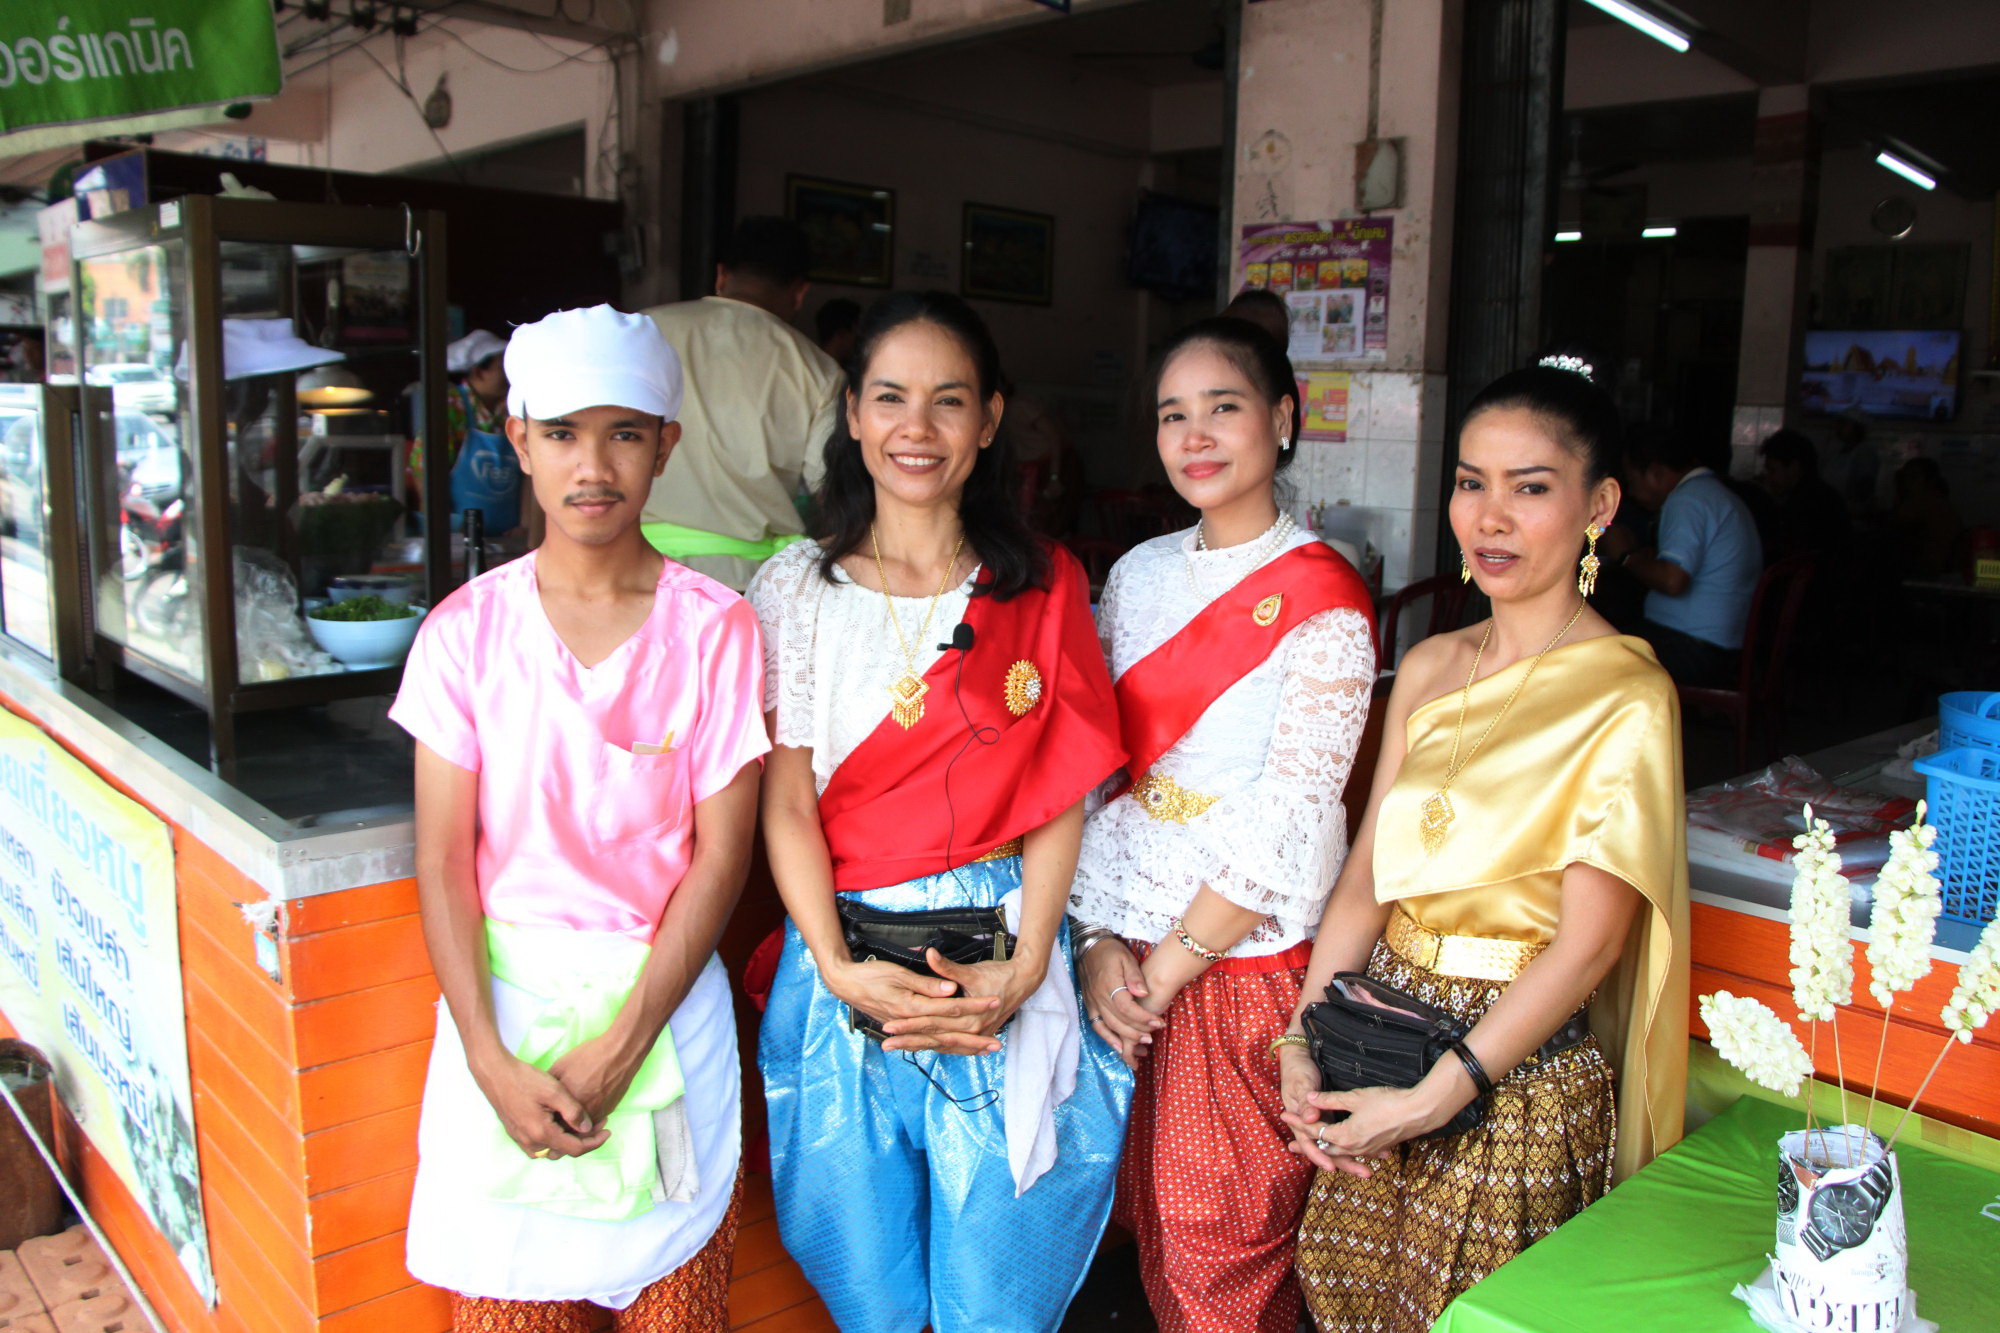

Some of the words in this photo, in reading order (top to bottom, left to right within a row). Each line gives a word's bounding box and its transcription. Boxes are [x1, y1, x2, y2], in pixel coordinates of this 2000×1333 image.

[50, 868, 131, 981] ข้าวเปล่า
[55, 935, 132, 1054] เส้นใหญ่
[63, 1003, 149, 1130] เส้นบะหมี่
